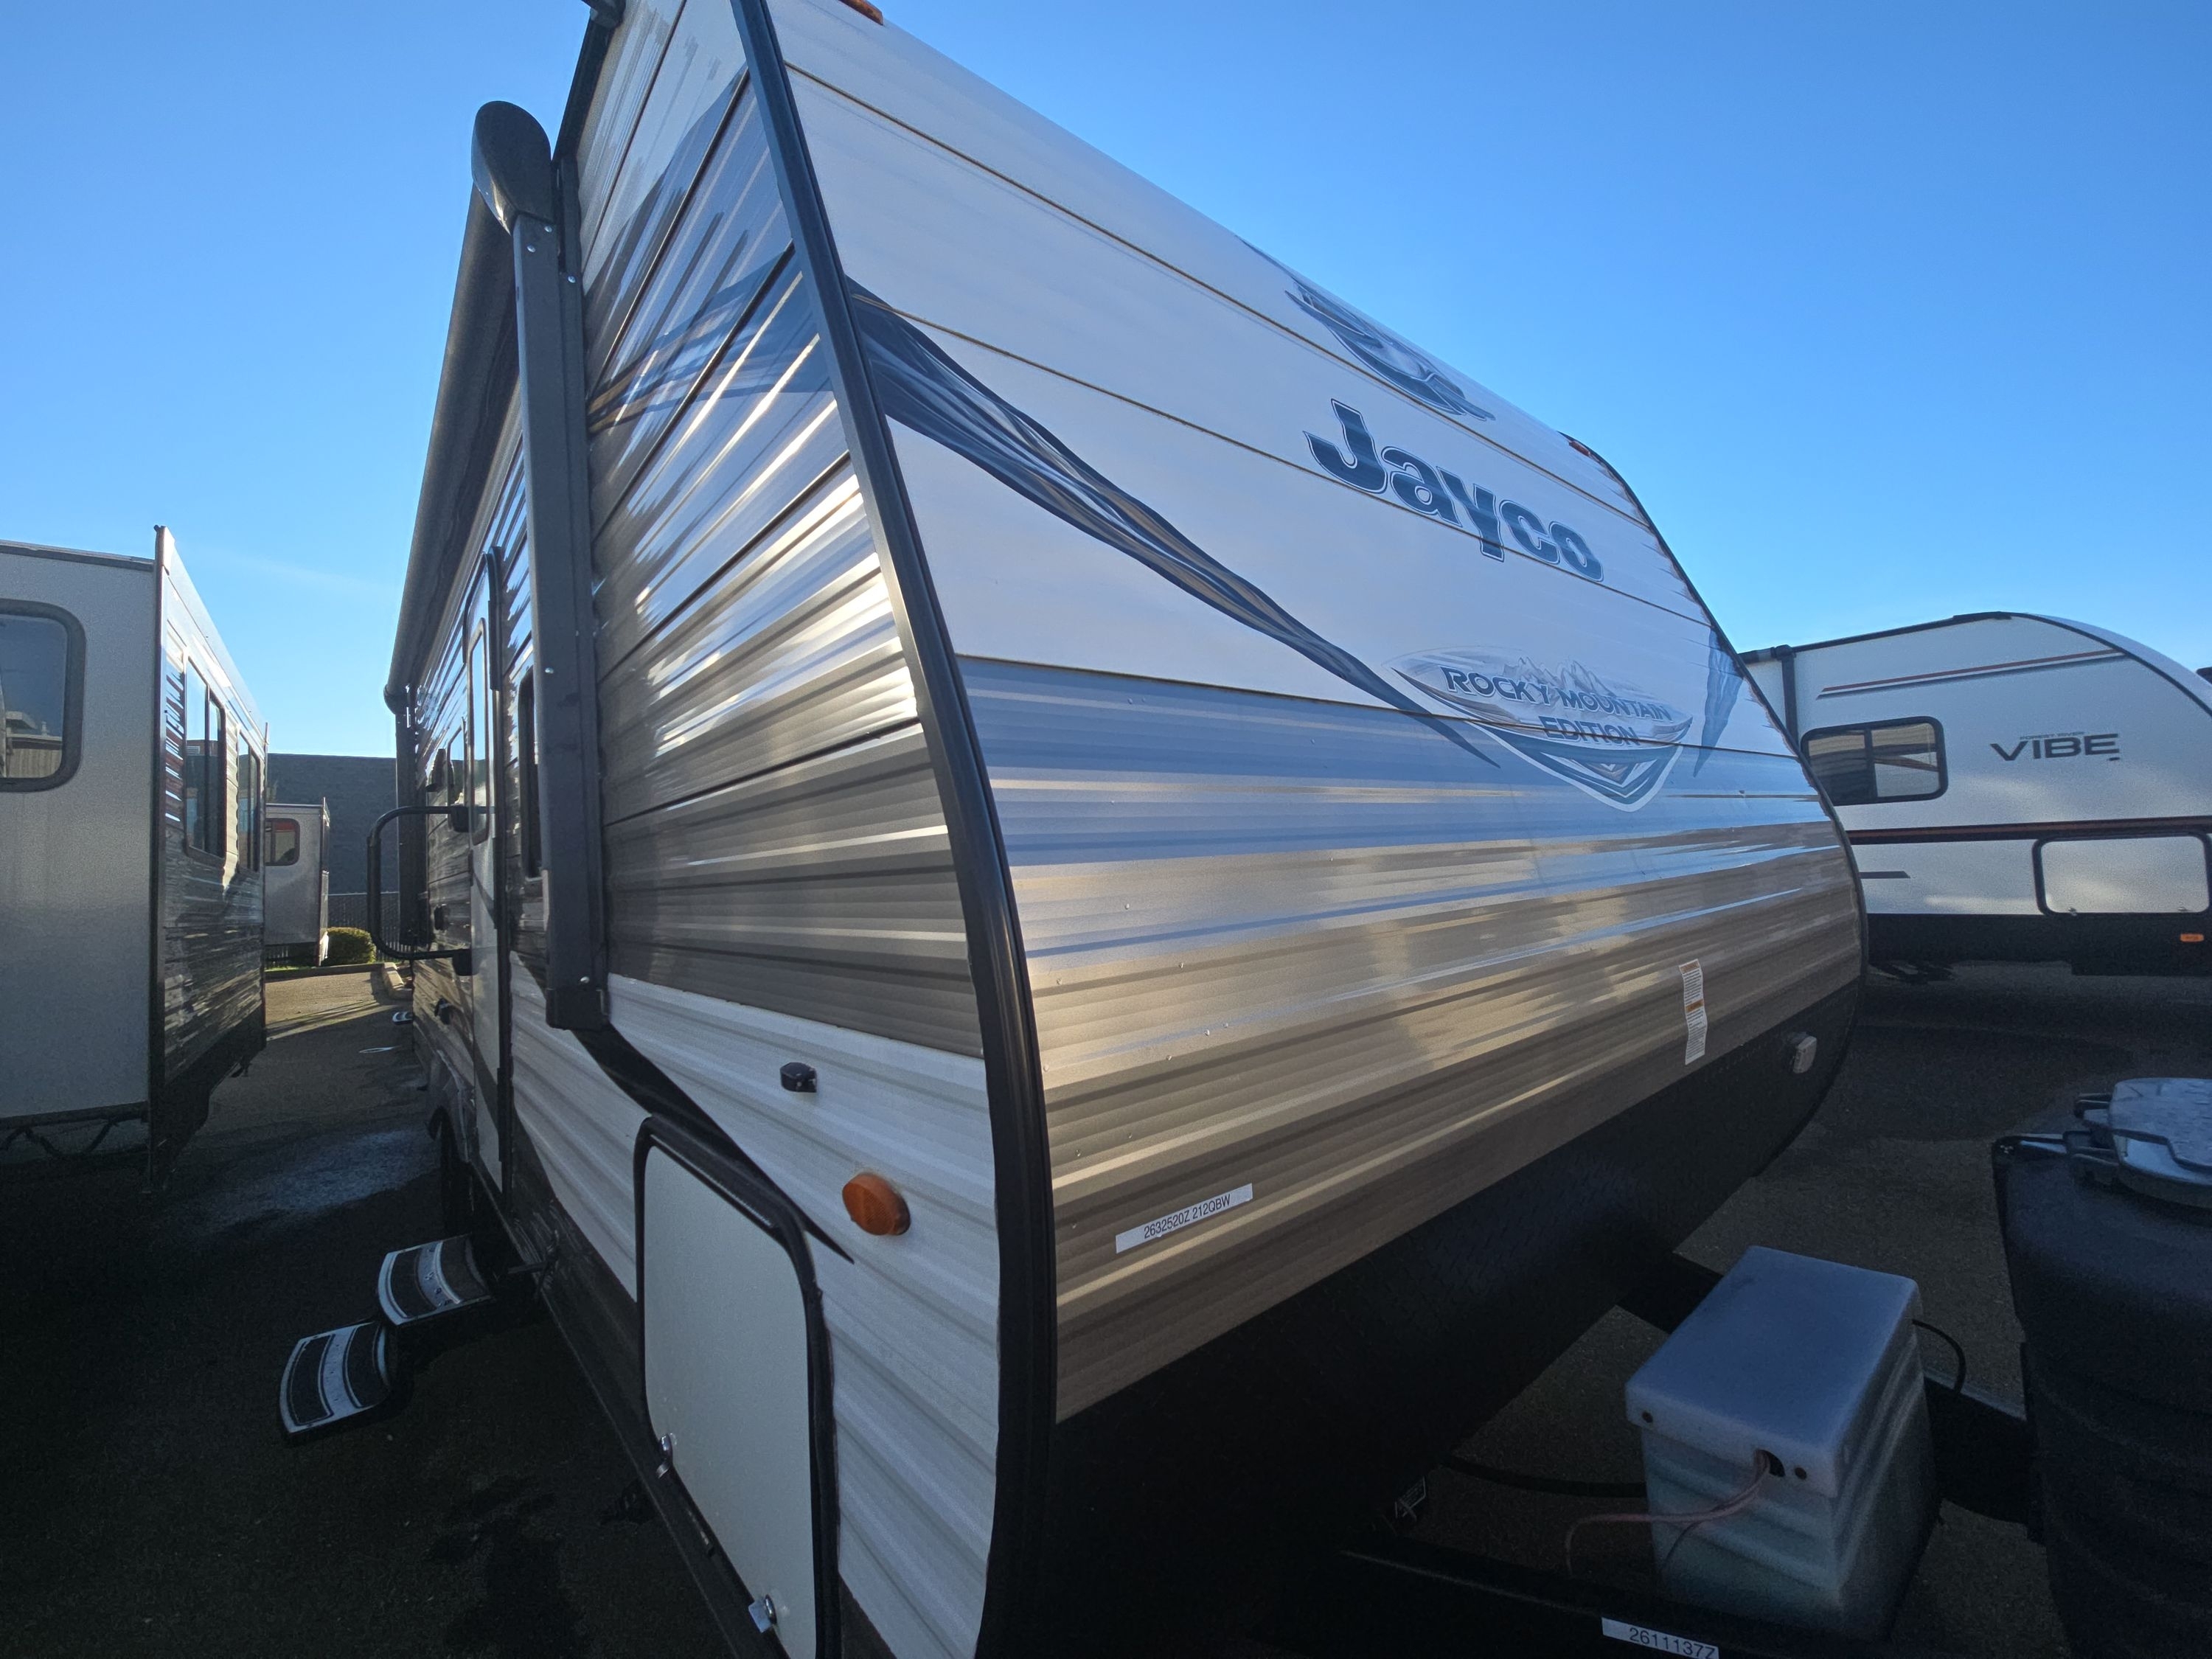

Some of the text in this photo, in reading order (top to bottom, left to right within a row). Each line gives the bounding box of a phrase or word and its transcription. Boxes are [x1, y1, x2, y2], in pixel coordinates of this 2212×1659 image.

[1303, 398, 1604, 582] Jayco
[1440, 667, 1674, 723] ROCKY MOUNTAIN
[1538, 716, 1641, 747] EDITION
[1990, 733, 2121, 762] VIBE
[1144, 1194, 1231, 1239] 2632520Z 212QBW
